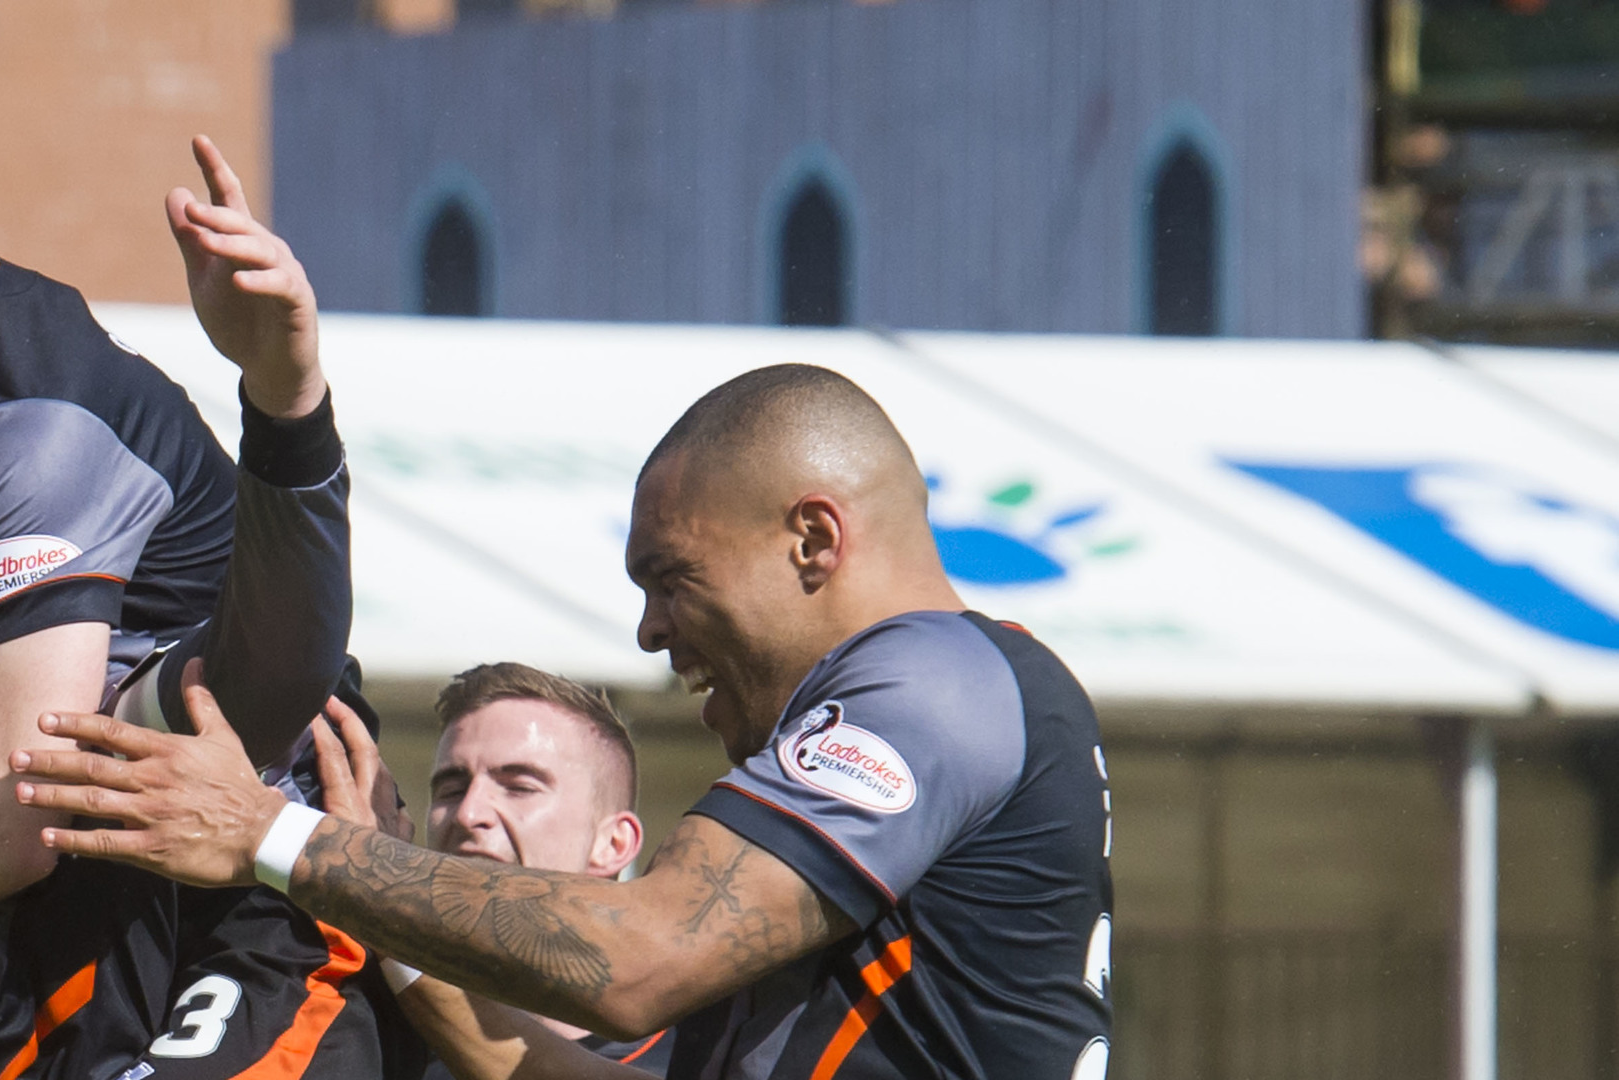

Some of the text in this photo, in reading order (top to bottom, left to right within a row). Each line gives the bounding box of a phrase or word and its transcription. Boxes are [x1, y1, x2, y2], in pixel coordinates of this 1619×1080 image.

[811, 752, 897, 800] PREMIERSHIP
[817, 734, 908, 790] Ladbrokes
[148, 973, 243, 1059] 3
